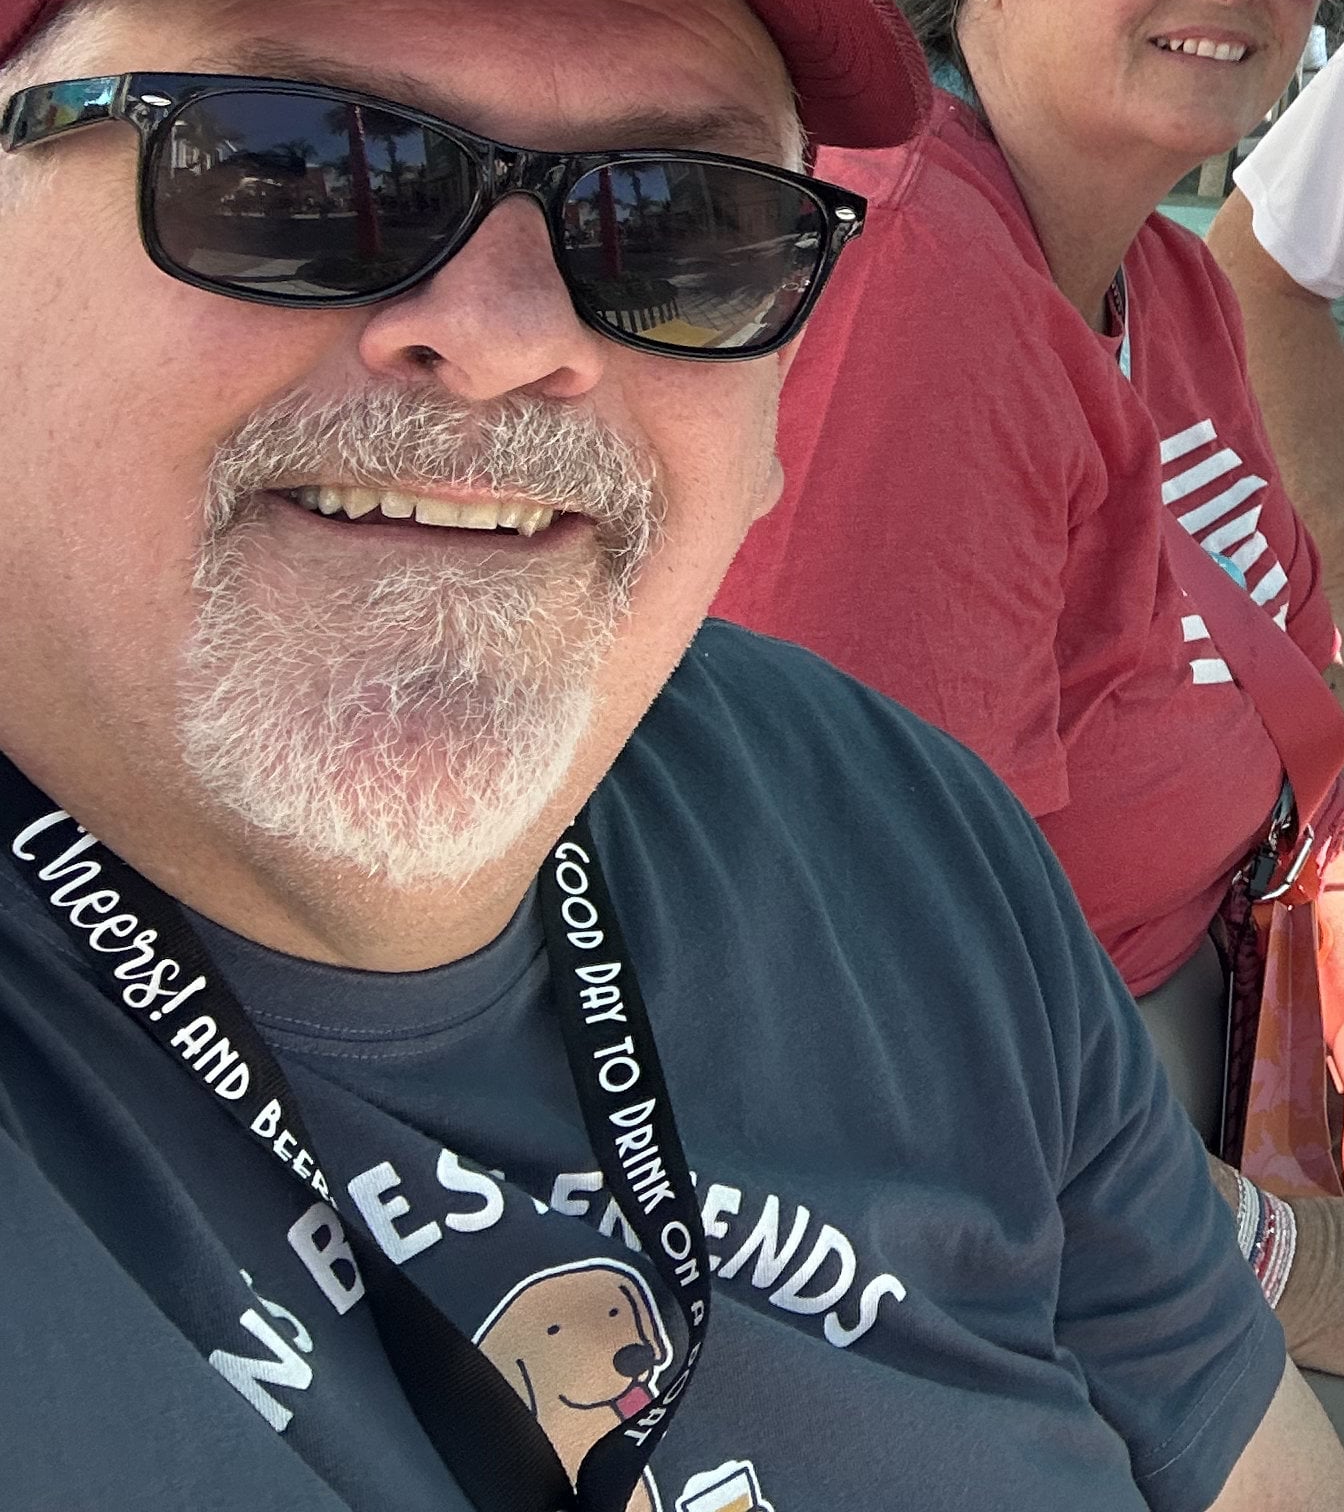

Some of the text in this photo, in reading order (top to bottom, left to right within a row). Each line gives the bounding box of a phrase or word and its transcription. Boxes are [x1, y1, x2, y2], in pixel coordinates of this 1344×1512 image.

[554, 841, 604, 950] GOOD
[11, 809, 341, 1212] Cheers! AND BEER
[574, 961, 628, 1025] DAY
[593, 1035, 641, 1094] TO
[608, 1096, 676, 1216] DRINK
[286, 1145, 550, 1316] BES
[660, 1199, 700, 1288] ON
[690, 1299, 705, 1327] A
